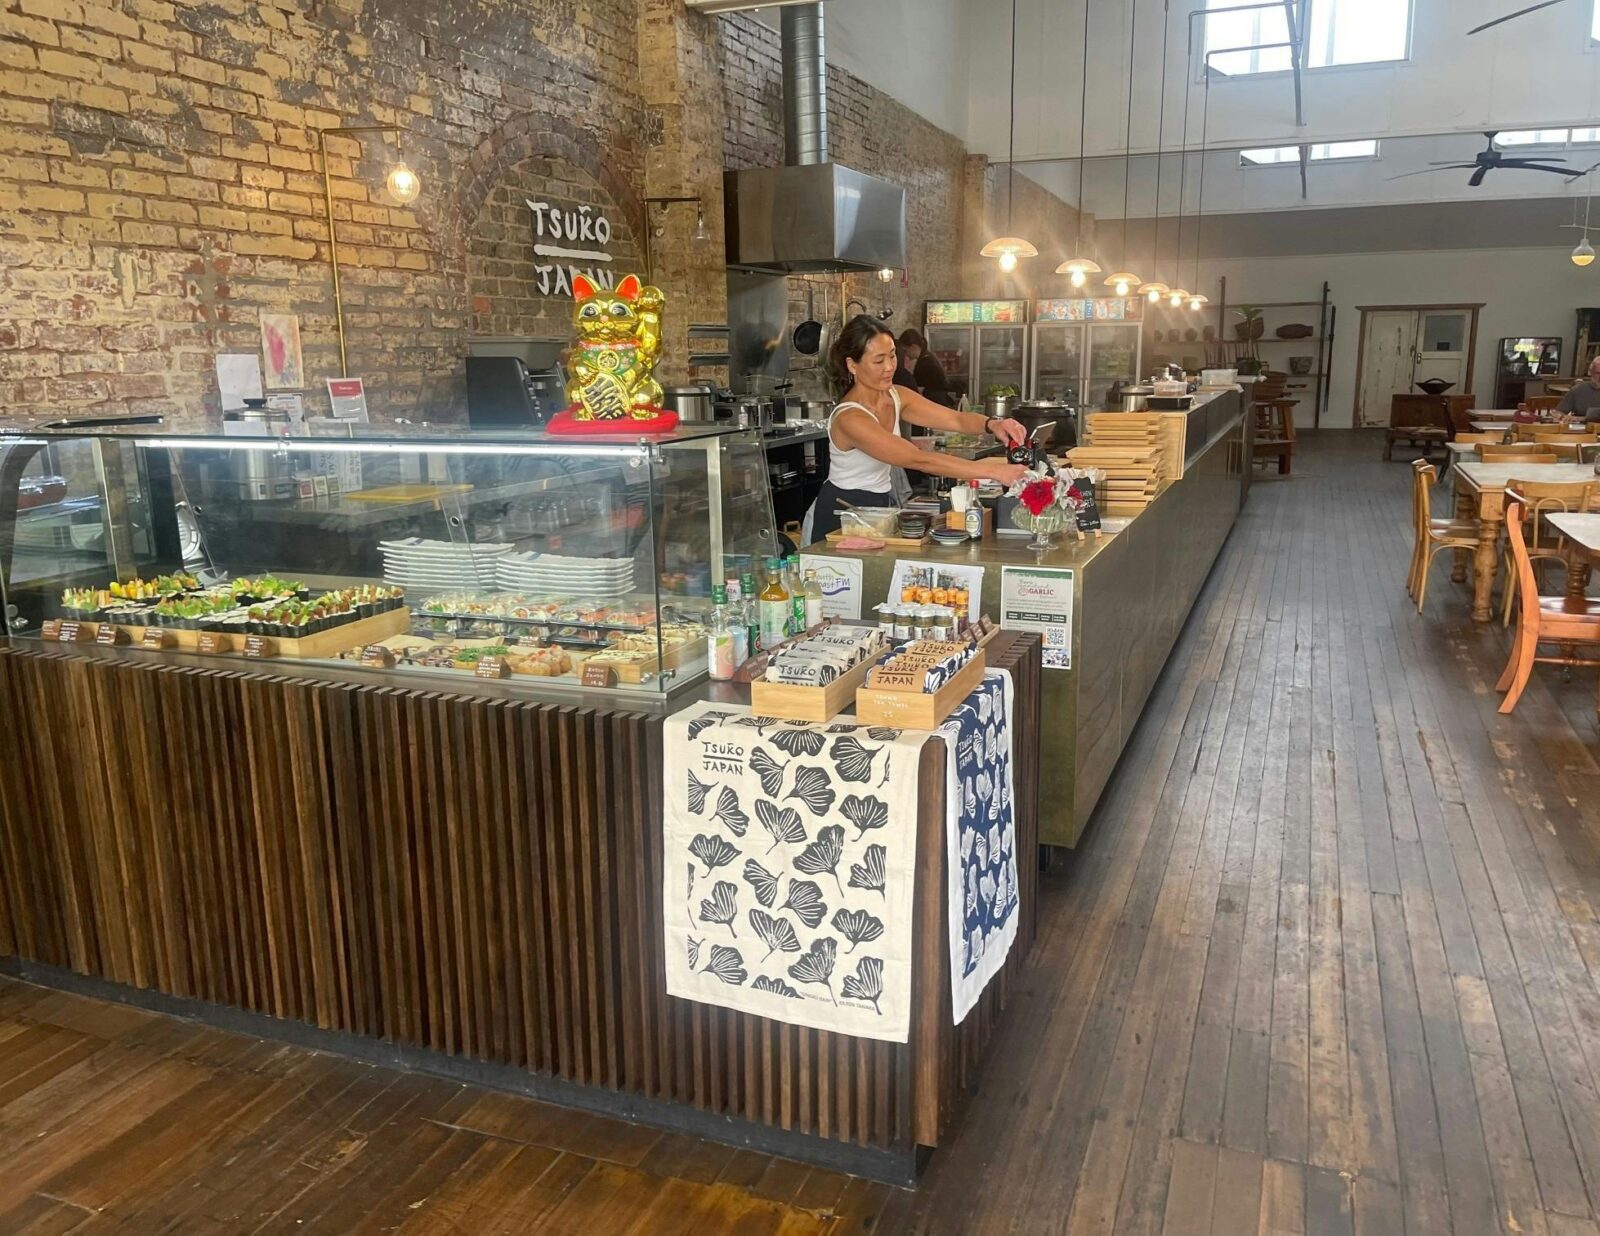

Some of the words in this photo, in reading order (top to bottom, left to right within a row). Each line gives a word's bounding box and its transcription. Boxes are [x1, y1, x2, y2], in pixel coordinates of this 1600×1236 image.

[1029, 587, 1055, 596] GARLIC
[877, 675, 914, 686] JAPAN
[702, 760, 743, 776] JAPAN
